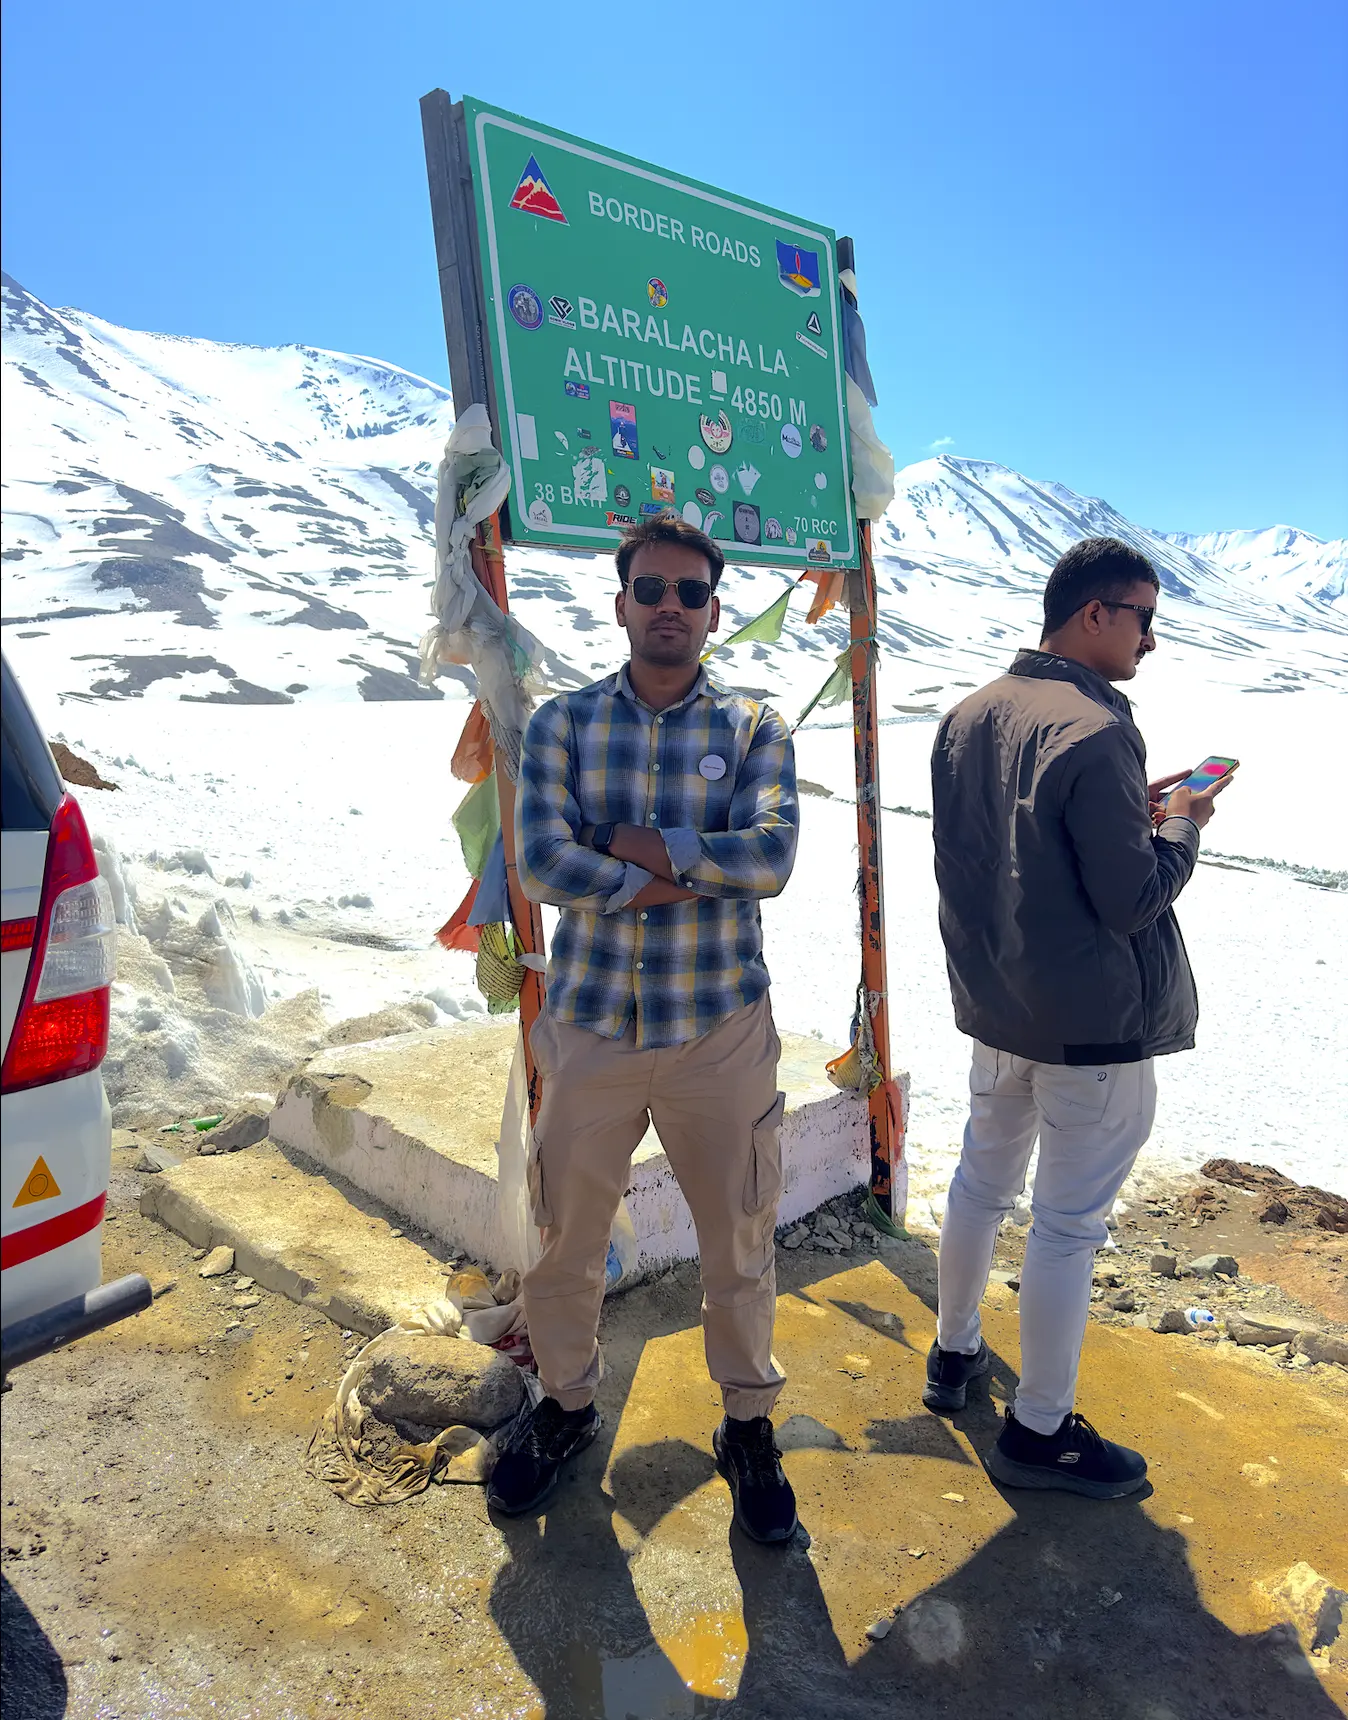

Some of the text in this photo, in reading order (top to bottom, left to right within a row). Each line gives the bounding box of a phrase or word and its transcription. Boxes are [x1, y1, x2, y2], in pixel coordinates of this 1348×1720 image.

[588, 190, 761, 268] BORDER ROADS
[578, 296, 753, 369] BARALACHA
[758, 344, 790, 378] LA
[563, 347, 703, 405] ALTITUDE
[731, 385, 783, 422] 4850
[789, 398, 807, 427] M
[534, 482, 555, 502] 38
[793, 516, 808, 533] 70
[811, 518, 838, 536] RCC
